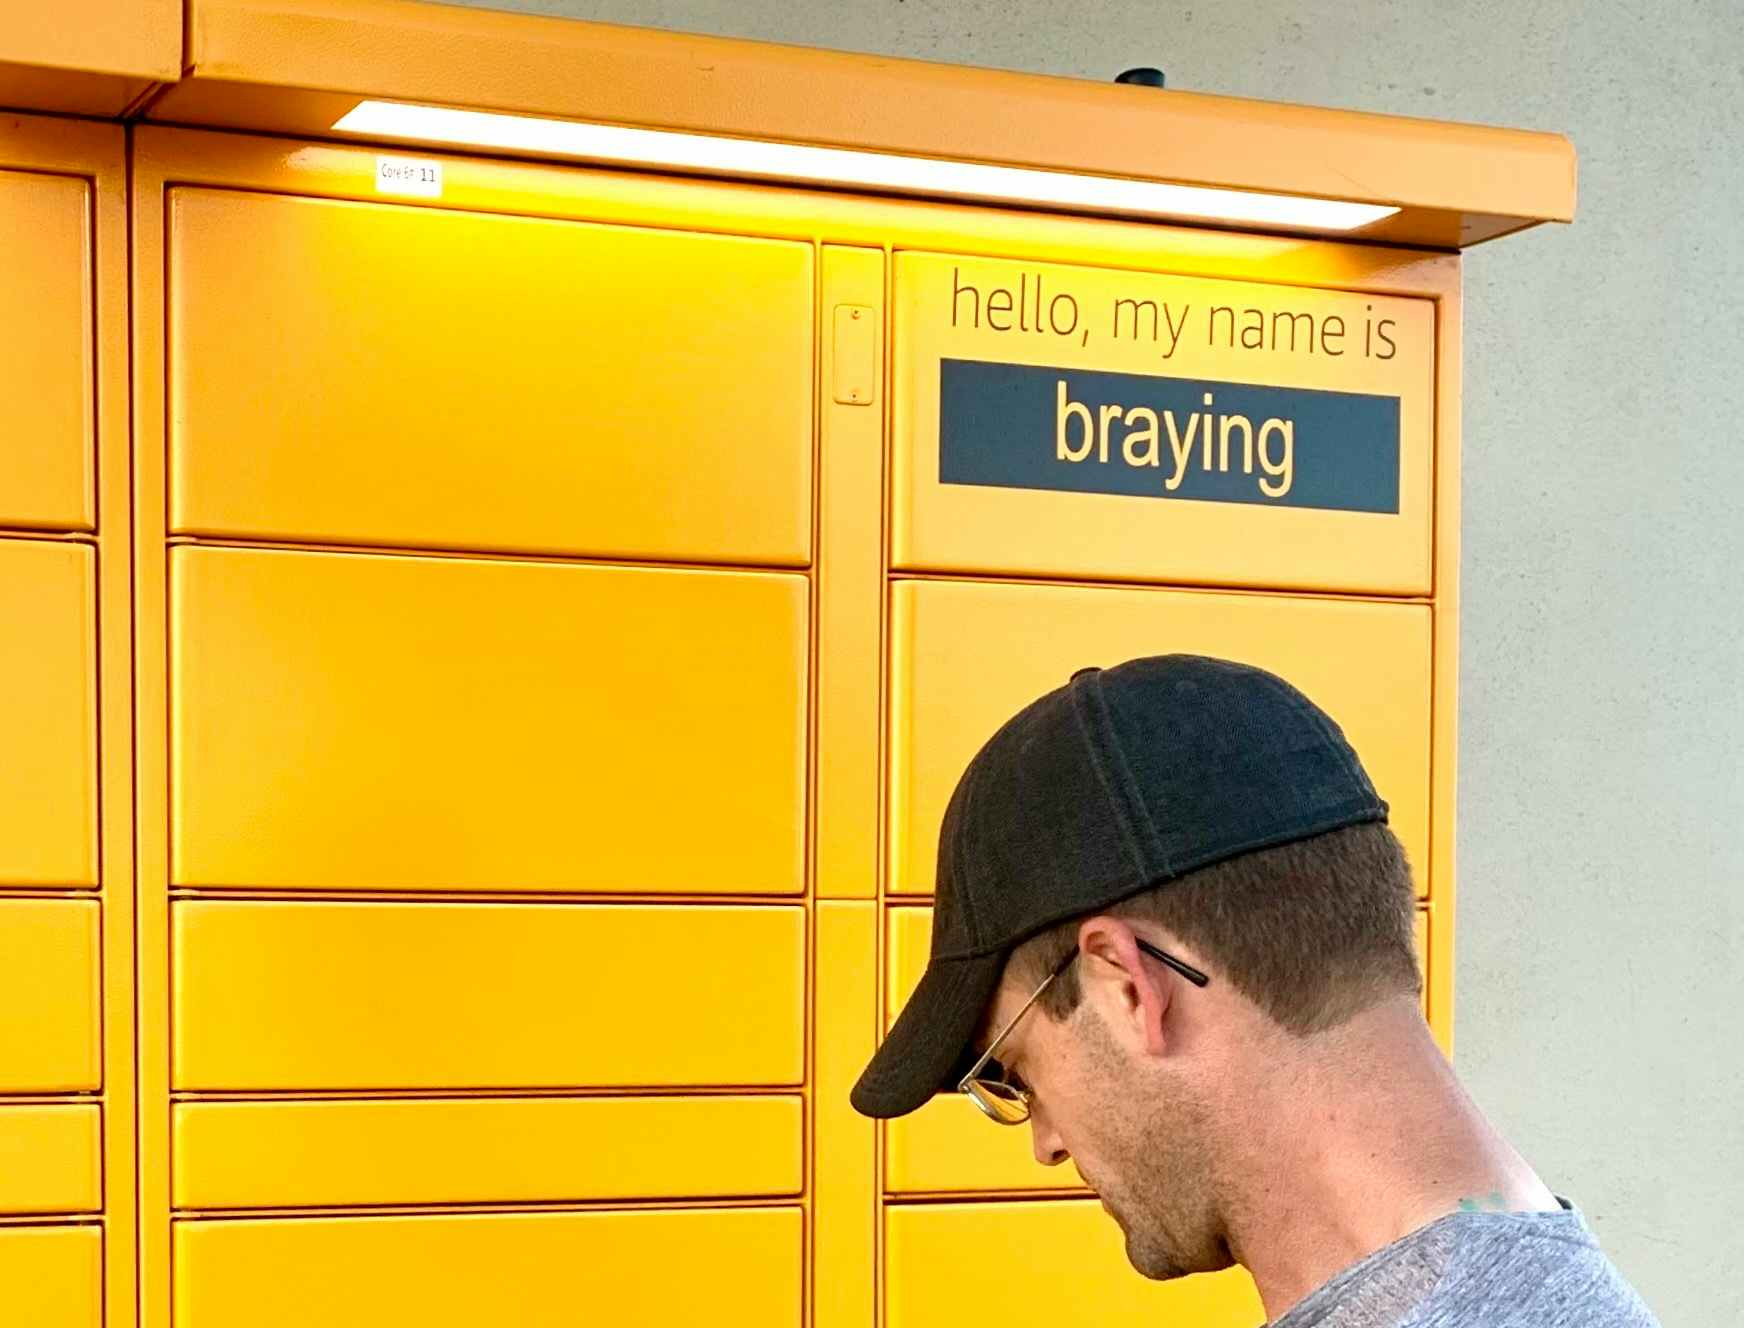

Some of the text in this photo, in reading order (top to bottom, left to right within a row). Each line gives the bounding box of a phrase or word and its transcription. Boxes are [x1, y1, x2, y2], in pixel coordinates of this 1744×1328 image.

[951, 267, 1397, 360] hello, my name is
[1056, 380, 1296, 499] braying
